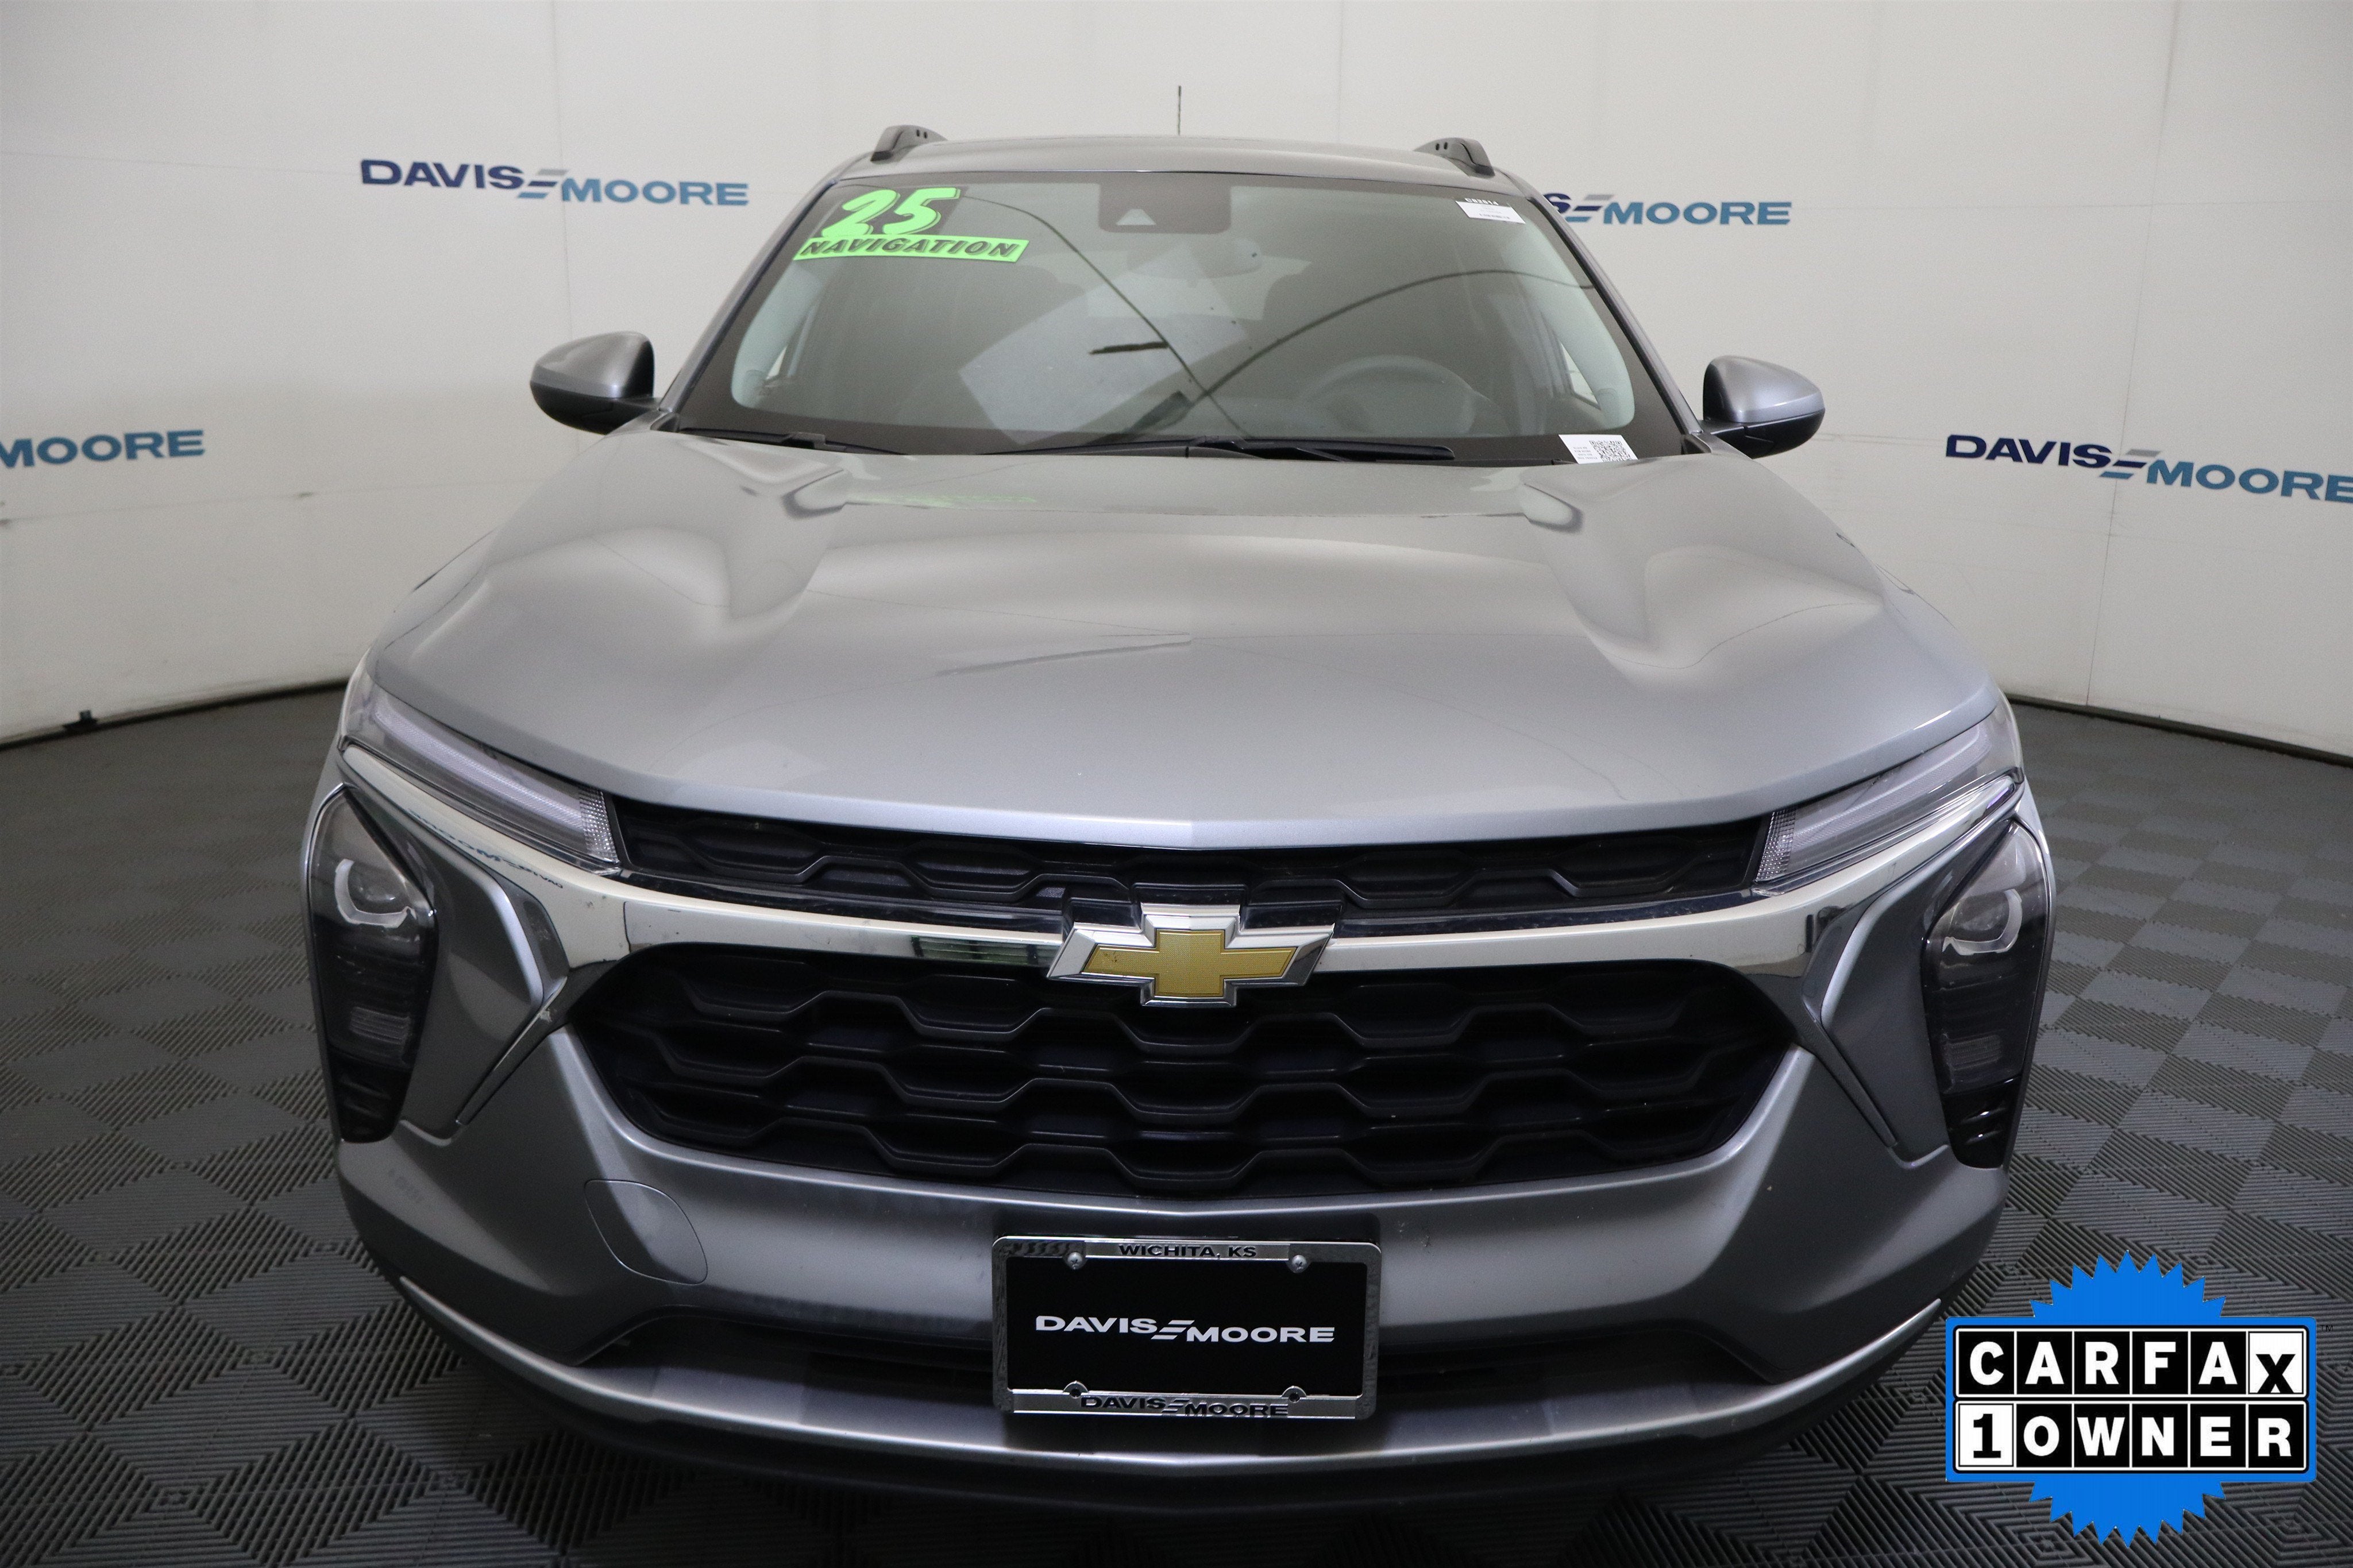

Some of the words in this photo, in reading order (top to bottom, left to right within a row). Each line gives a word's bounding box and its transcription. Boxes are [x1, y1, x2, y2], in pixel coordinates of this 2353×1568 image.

[361, 159, 525, 190] DAVIS
[561, 177, 750, 206] MOORE
[821, 187, 962, 237] 25
[1603, 201, 1792, 225] MOORE
[800, 237, 1020, 257] NAVIGATION
[0, 430, 205, 468] MOORE
[1946, 434, 2112, 468] DAVIS
[2146, 458, 2353, 504] MOORE
[1119, 1244, 1221, 1258] WICHITA,
[1228, 1246, 1257, 1257] KS
[1036, 1315, 1158, 1334] DAVIS
[1186, 1326, 1335, 1343] MOORE
[1081, 1396, 1166, 1408] DAVIS
[1185, 1402, 1289, 1418] MOORE
